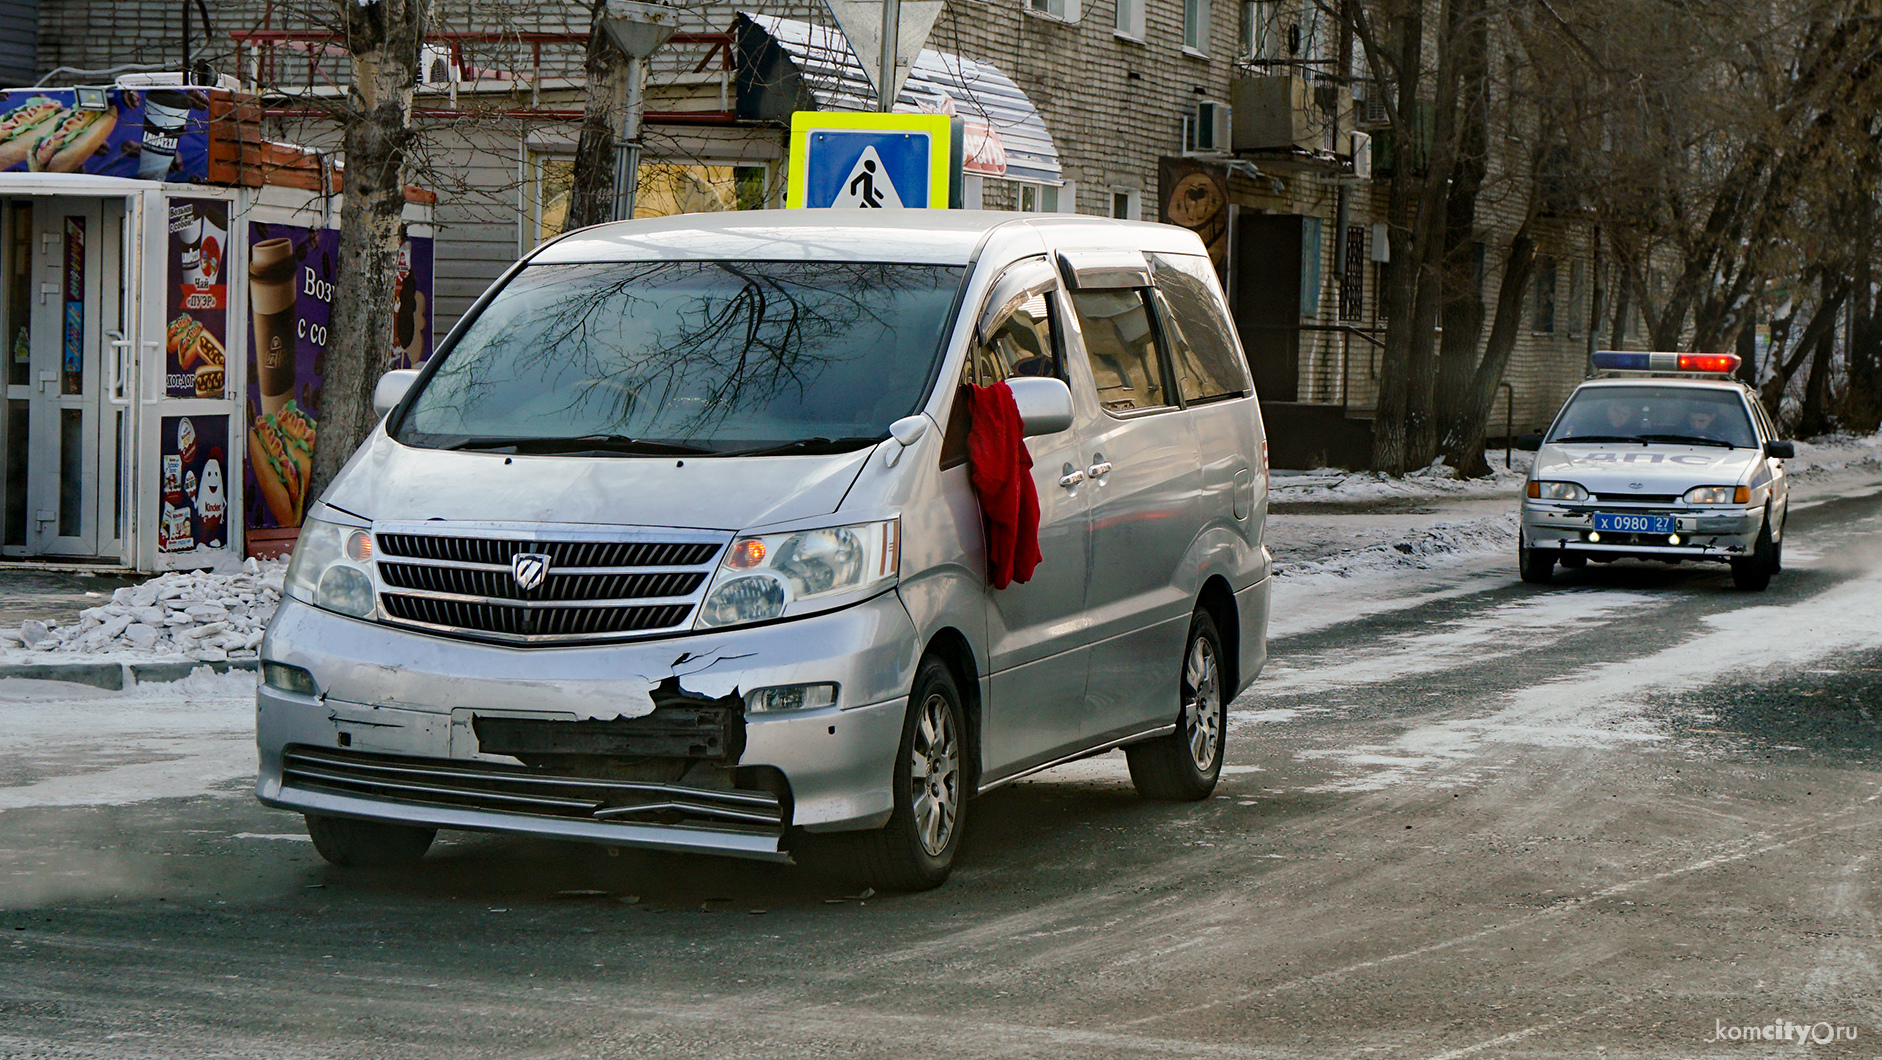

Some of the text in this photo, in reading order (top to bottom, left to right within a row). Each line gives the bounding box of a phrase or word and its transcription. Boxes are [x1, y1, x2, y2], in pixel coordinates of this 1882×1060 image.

[194, 277, 209, 289] Чай
[304, 266, 335, 303] Воз
[297, 318, 327, 347] с со
[1580, 452, 1711, 465] ДПС
[1614, 516, 1648, 530] 0980
[1656, 517, 1670, 528] 27
